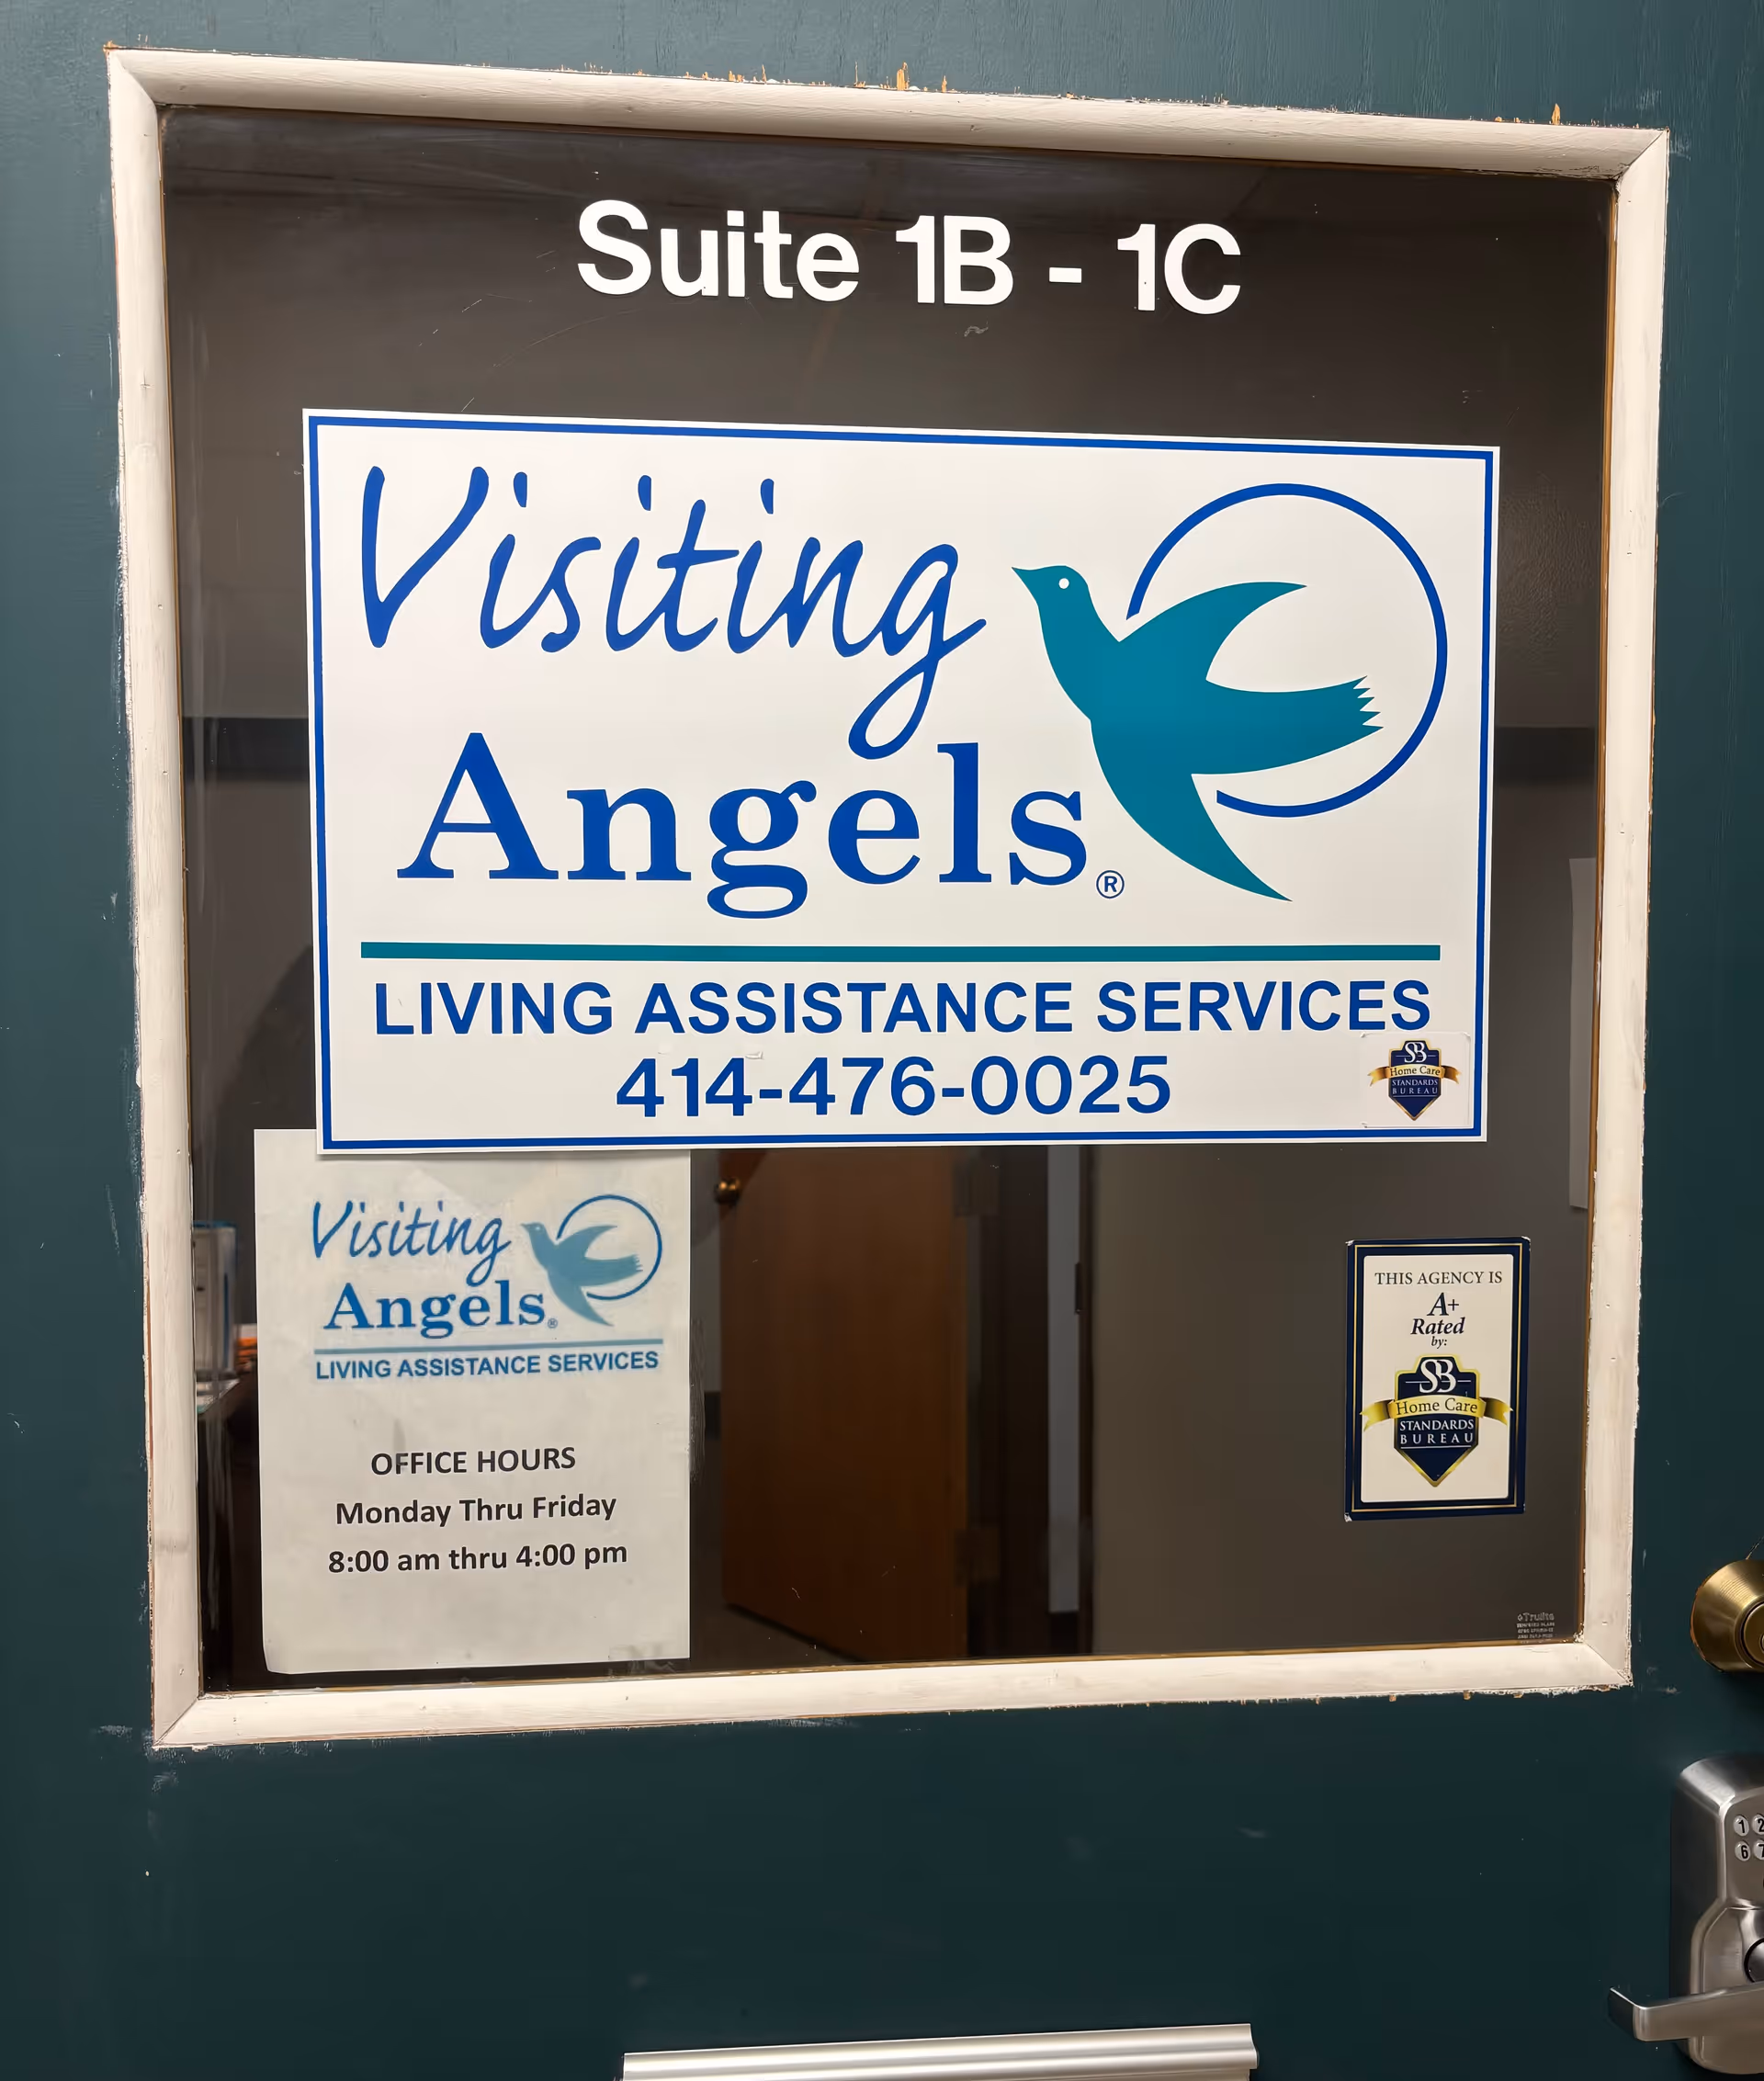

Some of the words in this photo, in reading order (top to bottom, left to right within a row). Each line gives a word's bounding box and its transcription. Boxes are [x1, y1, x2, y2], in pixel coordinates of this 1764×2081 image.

[577, 198, 859, 301] Suite
[895, 214, 1013, 306] 1B
[1116, 222, 1241, 315] 1C
[362, 466, 987, 760] Visiting
[397, 731, 1087, 919] Angels
[376, 981, 613, 1035] LIVING
[634, 980, 1073, 1035] ASSISTANCE
[1097, 979, 1430, 1032] SERVICES
[616, 1055, 1170, 1117] 414-476-0025
[1390, 1067, 1418, 1077] Home
[1419, 1066, 1441, 1076] Care
[311, 1200, 511, 1287] Visiting
[1374, 1272, 1413, 1285] THIS
[1417, 1271, 1485, 1284] AGENCY
[1488, 1271, 1503, 1284] IS
[323, 1279, 546, 1340] Angels
[1427, 1292, 1460, 1317] A+
[1410, 1317, 1465, 1335] Rated
[1430, 1336, 1448, 1350] by:
[316, 1359, 392, 1380] LIVING
[397, 1354, 541, 1377] ASSISTANCE
[547, 1351, 659, 1372] SERVICES
[1396, 1400, 1441, 1416] Home
[1444, 1398, 1478, 1414] Care
[1399, 1419, 1475, 1431] STANDARDS
[1400, 1432, 1474, 1445] BUREAU
[370, 1451, 467, 1476] OFFICE
[476, 1446, 576, 1472] HOURS
[336, 1500, 452, 1527] Monday
[458, 1498, 524, 1522] Thru
[532, 1495, 616, 1521] Friday
[328, 1550, 390, 1574] 8:00
[397, 1553, 441, 1571] am
[448, 1545, 507, 1569] thru
[515, 1543, 576, 1566] 4:00
[583, 1545, 628, 1568] pm
[1738, 1819, 1746, 1834] 1
[1740, 1845, 1748, 1859] 6
